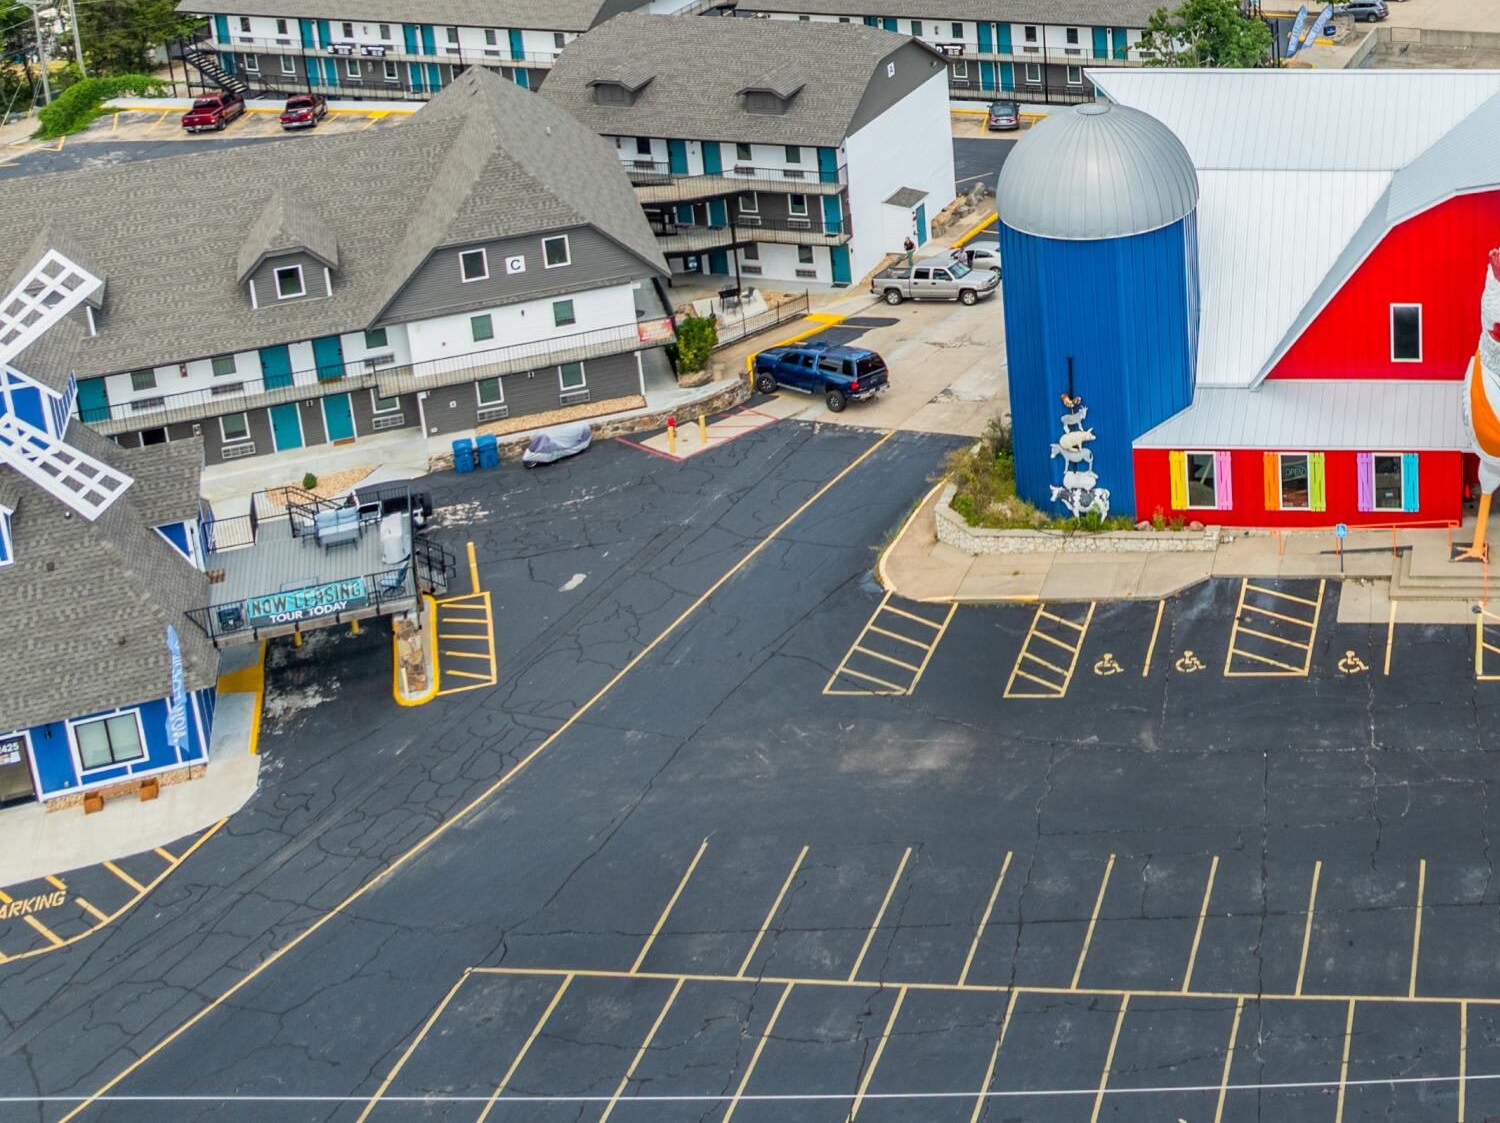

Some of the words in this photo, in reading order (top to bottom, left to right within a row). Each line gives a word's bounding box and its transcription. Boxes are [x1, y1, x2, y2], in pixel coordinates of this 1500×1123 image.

[510, 259, 521, 271] C
[252, 596, 288, 616] NOW
[294, 580, 361, 608] LEASING
[269, 610, 303, 624] TOUR
[308, 601, 348, 617] TODAY
[0, 742, 19, 755] 425
[0, 890, 66, 920] ARKING
